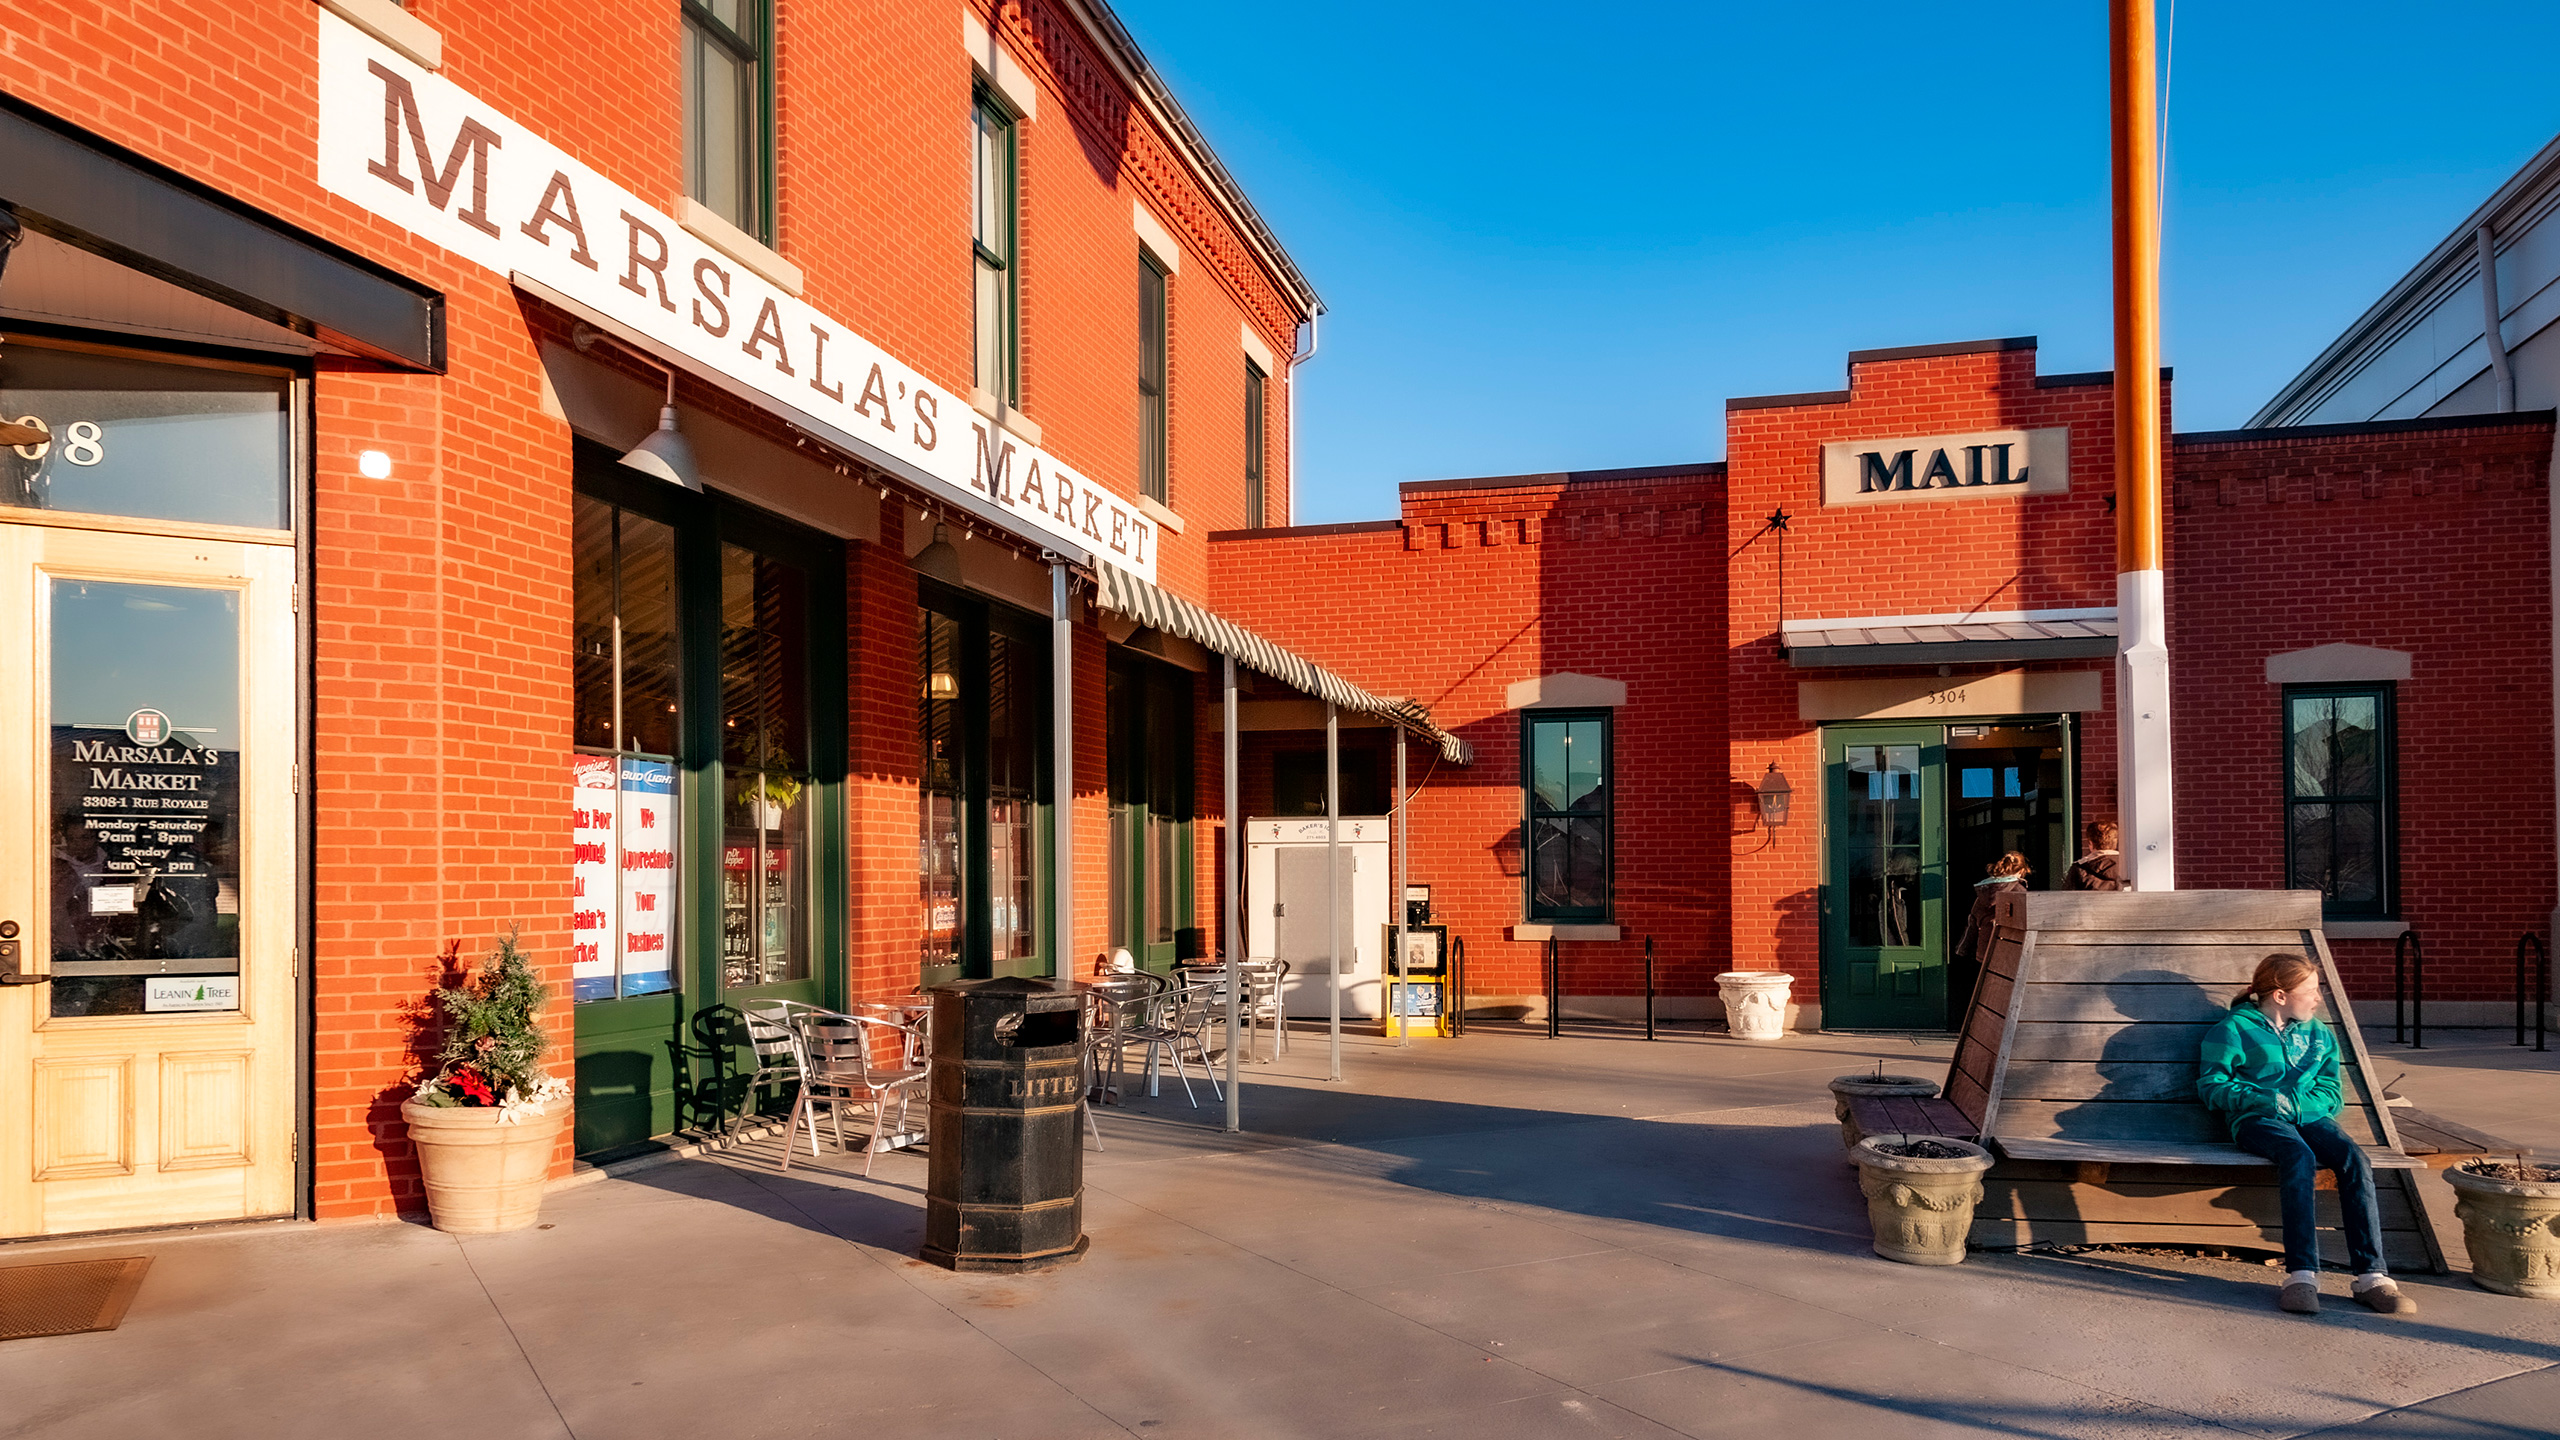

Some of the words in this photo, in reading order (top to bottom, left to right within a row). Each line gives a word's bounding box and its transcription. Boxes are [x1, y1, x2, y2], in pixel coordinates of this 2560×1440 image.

[366, 57, 938, 453] MARSALA'S
[970, 420, 1149, 565] MARKET
[1854, 442, 2030, 494] MAIL
[1927, 689, 1966, 705] 3304
[71, 740, 219, 765] MARSALA'S
[89, 767, 202, 791] MARKET
[621, 770, 643, 781] BUD
[647, 773, 674, 785] LIGHT
[82, 796, 128, 808] 3308-1
[132, 797, 159, 808] RUE
[161, 798, 209, 810] ROYALE
[592, 808, 612, 830] For
[640, 807, 655, 829] We
[98, 830, 136, 843] 9am
[157, 831, 194, 846] 8pm
[122, 846, 171, 859] Sunday
[621, 848, 674, 872] Appreciate
[725, 851, 745, 867] Pepper
[574, 876, 585, 897] At
[635, 891, 656, 912] Your
[573, 909, 606, 930] sala's
[627, 931, 664, 953] Business
[206, 986, 232, 998] TREE
